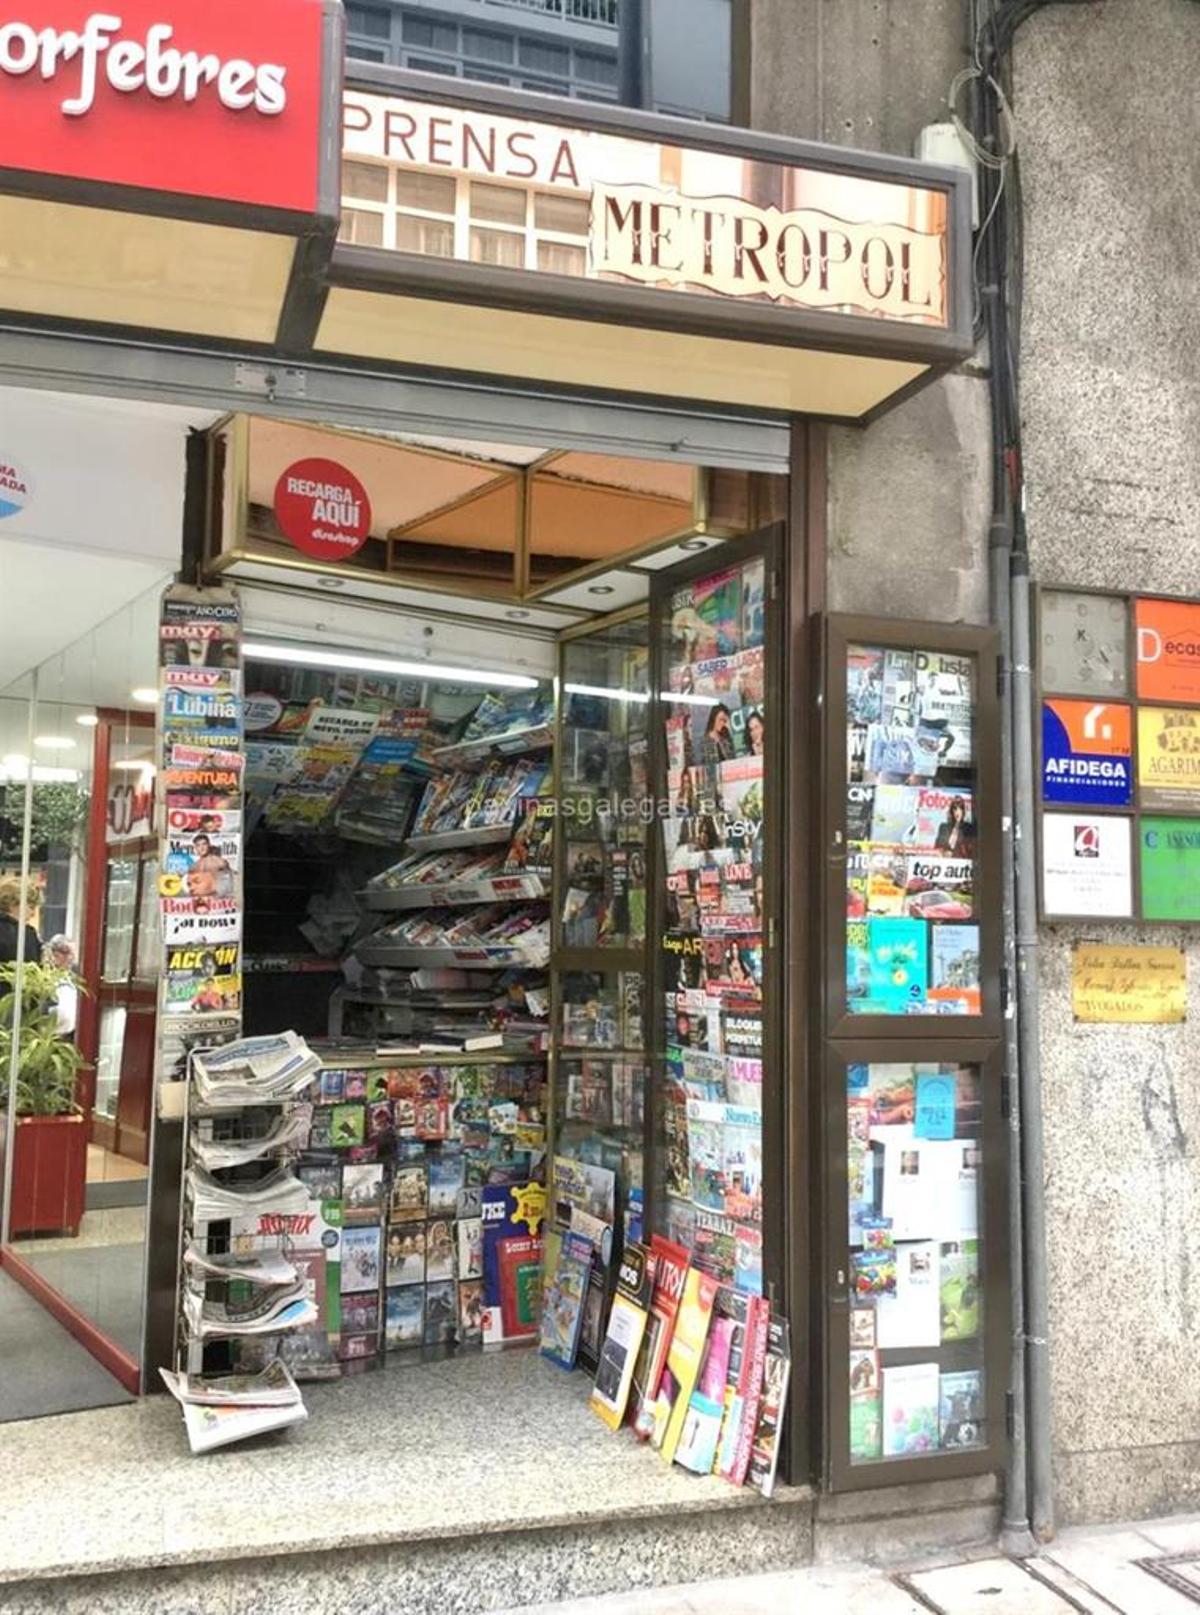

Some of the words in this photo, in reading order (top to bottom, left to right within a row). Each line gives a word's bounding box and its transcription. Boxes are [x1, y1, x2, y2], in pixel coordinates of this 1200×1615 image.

[0, 14, 287, 116] orfebres
[343, 103, 580, 187] PRENSA
[604, 196, 932, 306] METROPOL
[287, 477, 353, 503] RECARGA
[312, 500, 361, 528] AQUÍ
[1045, 757, 1127, 779] AFIDEGA
[913, 860, 941, 879] top
